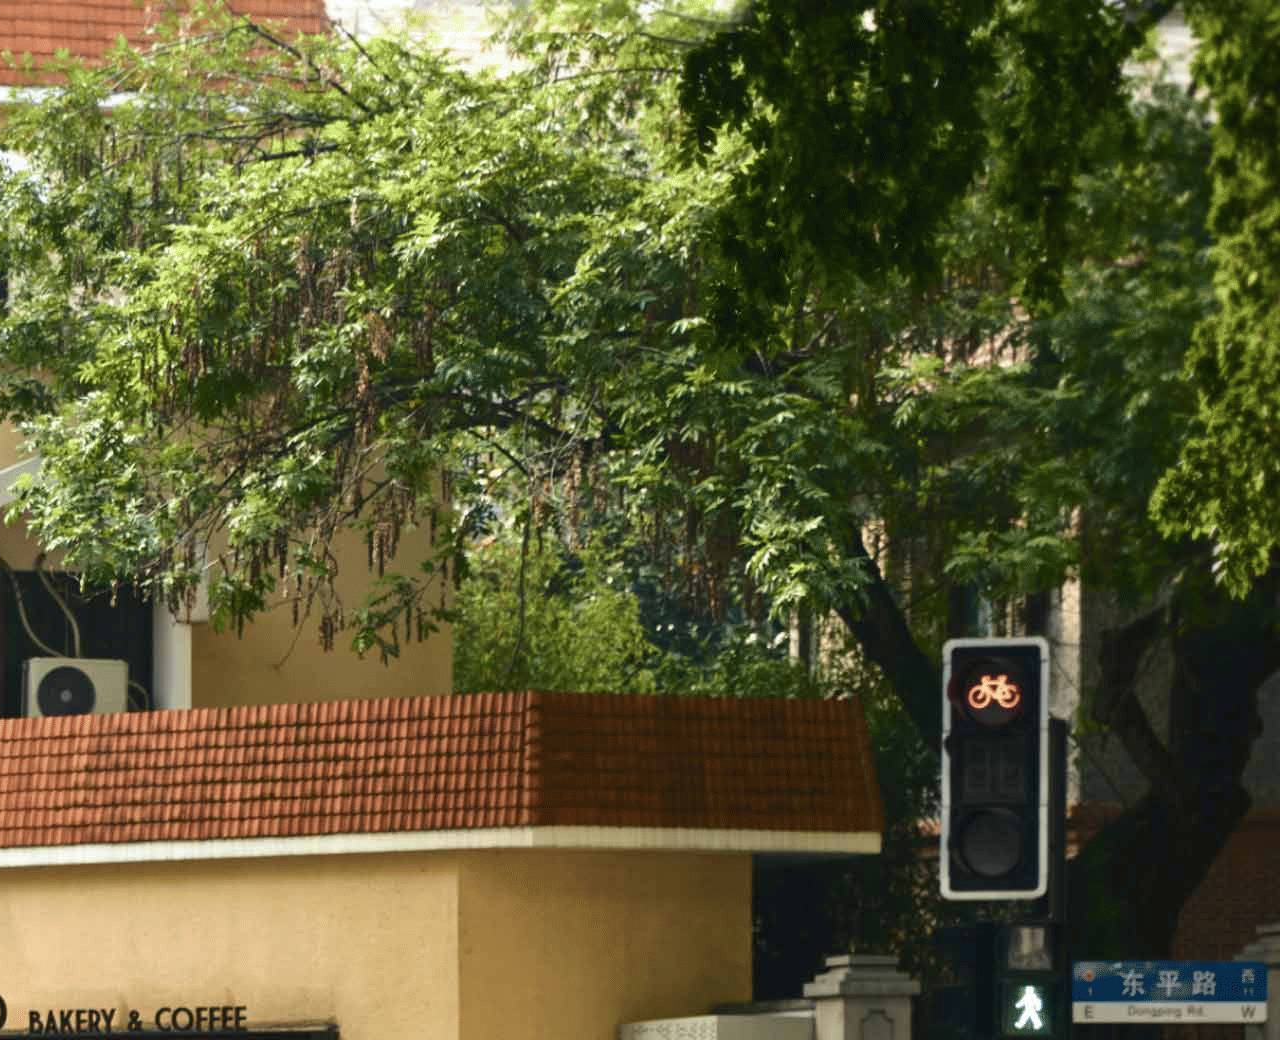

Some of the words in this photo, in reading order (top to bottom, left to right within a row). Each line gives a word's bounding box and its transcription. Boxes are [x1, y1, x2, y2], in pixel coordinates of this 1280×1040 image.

[1122, 969, 1217, 997] 东平路
[28, 1008, 116, 1033] BAKERY
[127, 1009, 143, 1032] &
[154, 1006, 248, 1032] COFFEE
[1084, 1005, 1094, 1018] E
[1241, 1005, 1256, 1018] W
